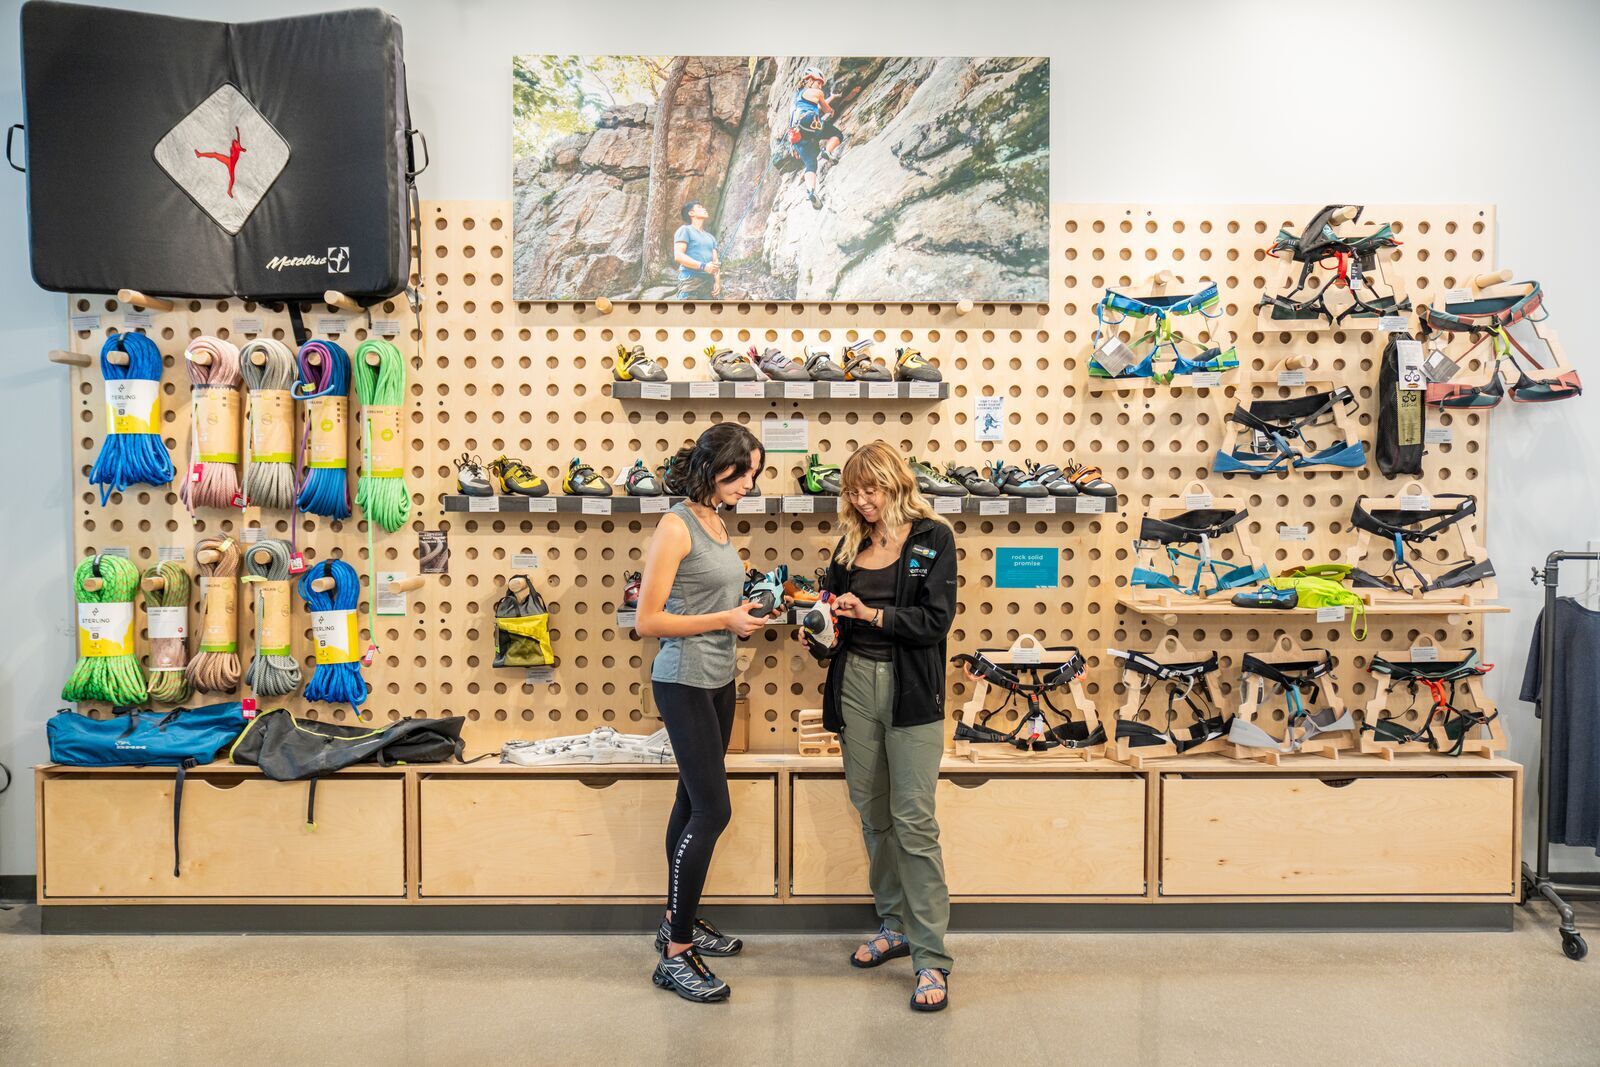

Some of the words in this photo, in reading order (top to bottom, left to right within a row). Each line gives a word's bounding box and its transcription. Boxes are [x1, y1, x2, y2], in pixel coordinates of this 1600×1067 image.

[265, 254, 328, 272] Metolius
[677, 833, 693, 857] SEEK
[672, 859, 681, 914] DISCOMFORT
